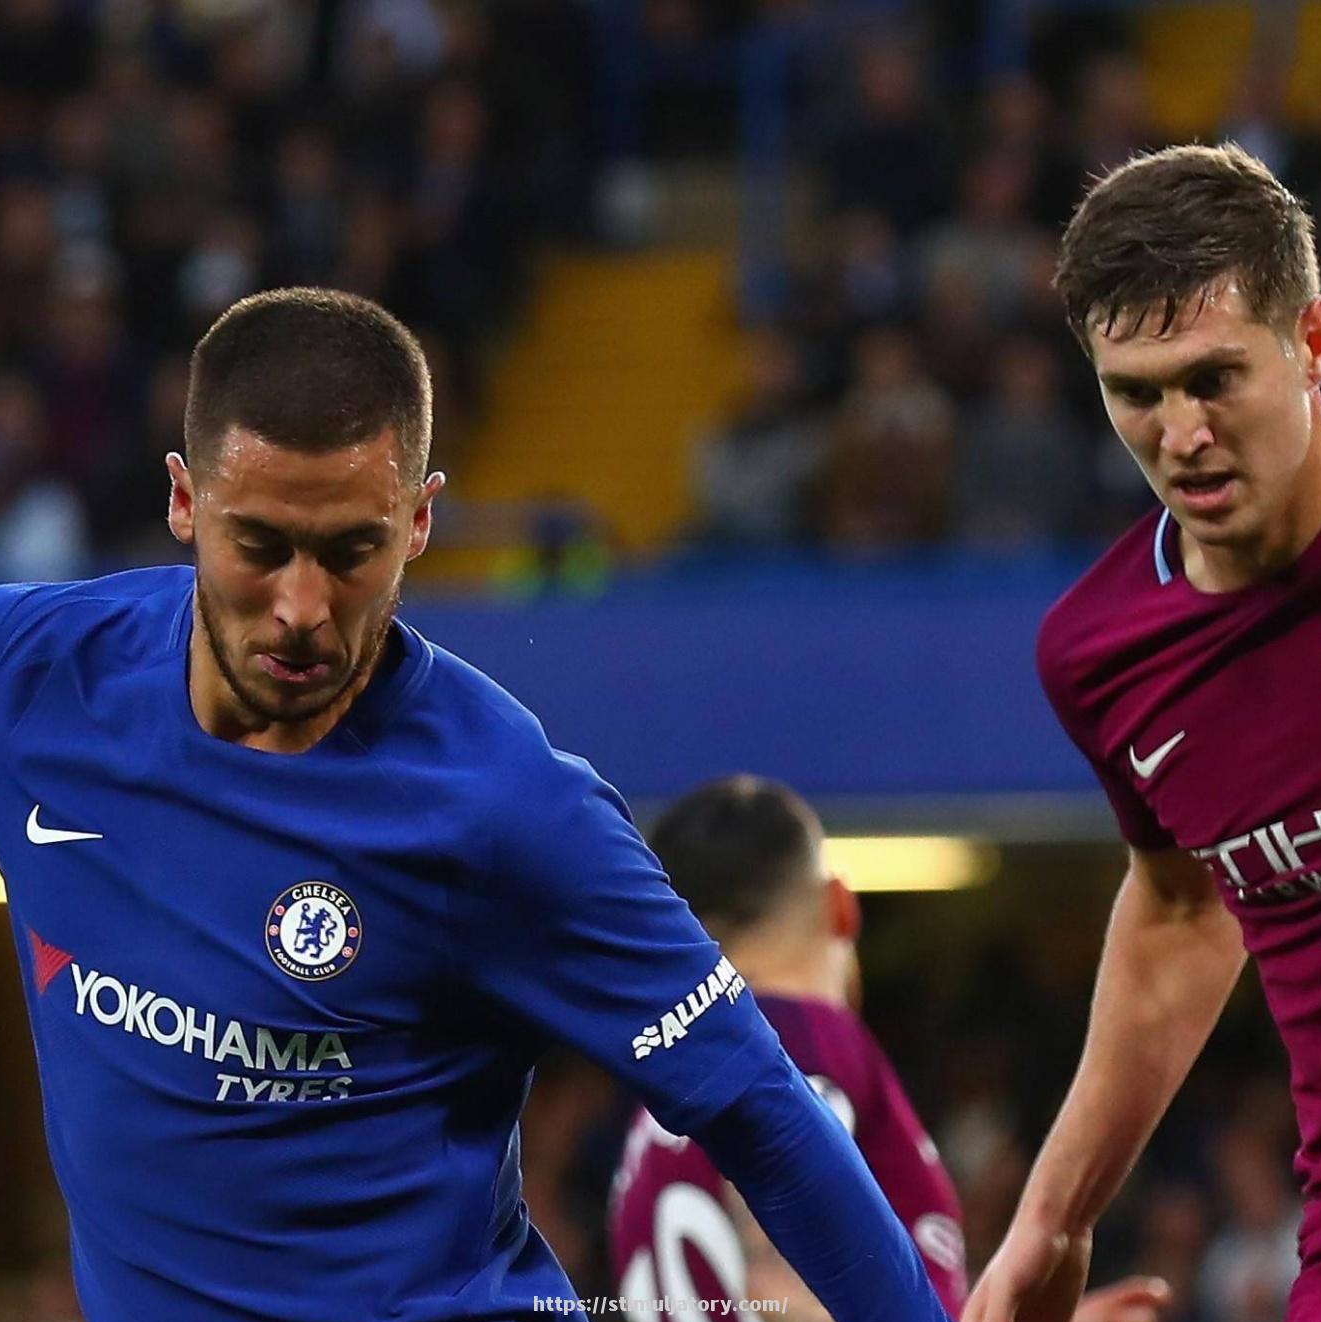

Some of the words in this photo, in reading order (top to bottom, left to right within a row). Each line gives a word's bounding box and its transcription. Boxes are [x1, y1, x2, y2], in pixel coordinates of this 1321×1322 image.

[291, 885, 352, 916] CHELSEA
[273, 948, 310, 976] FOOTBALL
[312, 963, 336, 976] CLUB
[71, 963, 353, 1071] YOKOHAMA
[215, 1073, 353, 1102] TYRES
